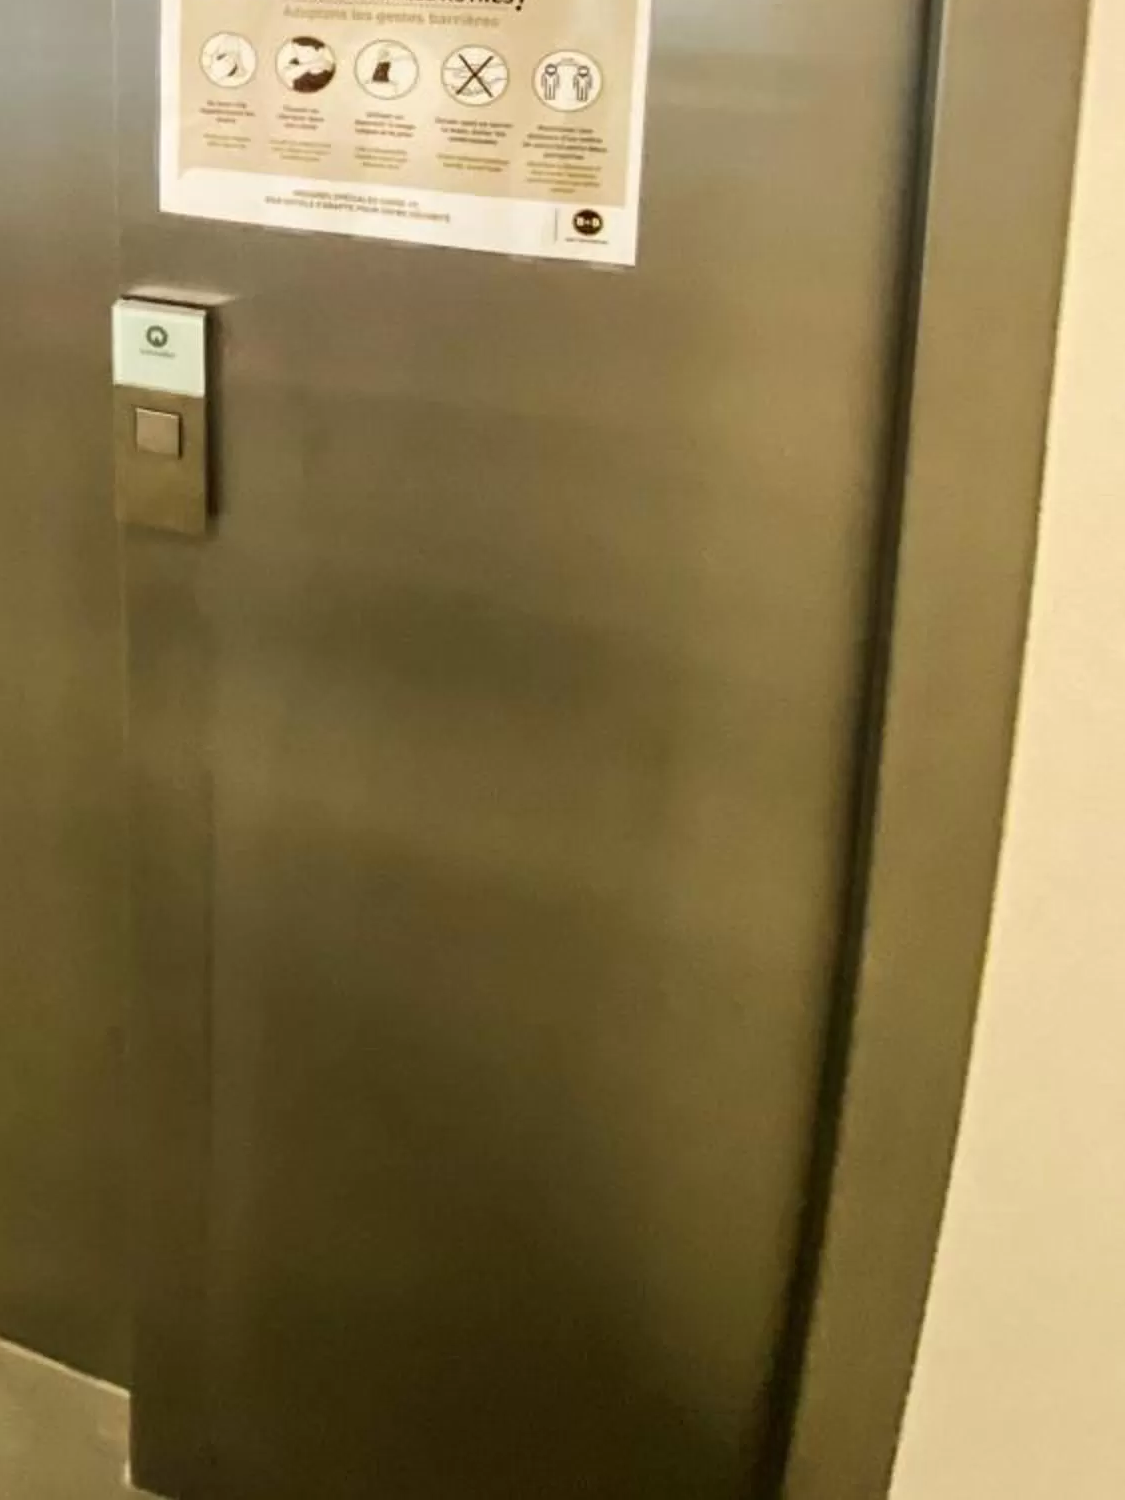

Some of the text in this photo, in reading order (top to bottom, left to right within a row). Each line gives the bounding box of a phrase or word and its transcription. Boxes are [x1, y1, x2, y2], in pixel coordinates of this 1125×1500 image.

[352, 6, 373, 21] les
[375, 8, 426, 26] gestes
[428, 11, 500, 28] barrières
